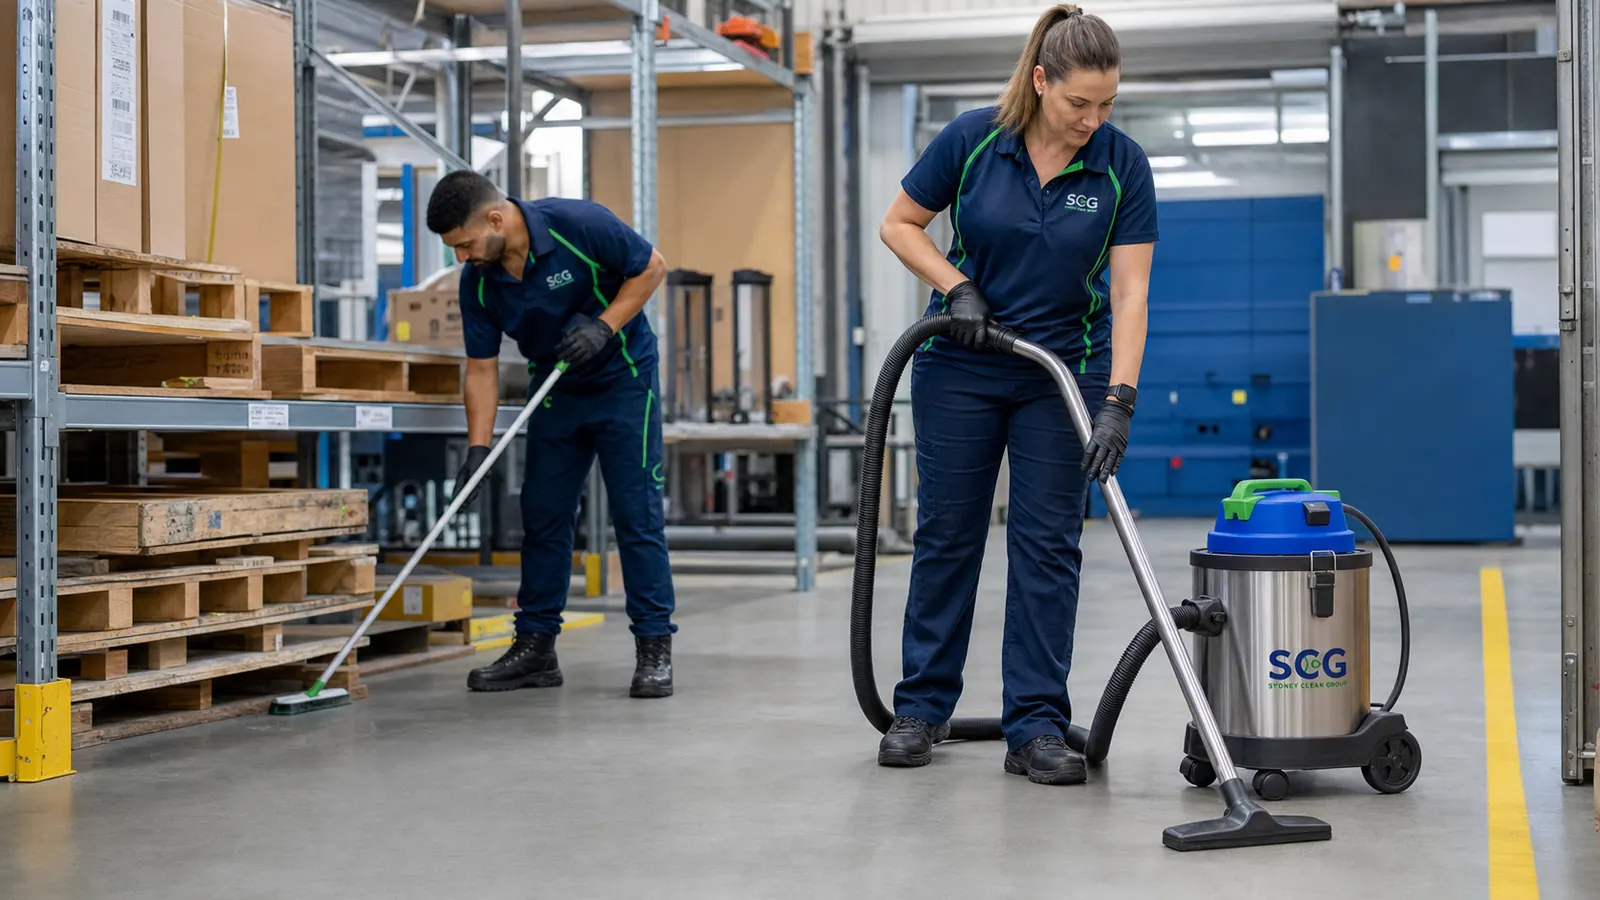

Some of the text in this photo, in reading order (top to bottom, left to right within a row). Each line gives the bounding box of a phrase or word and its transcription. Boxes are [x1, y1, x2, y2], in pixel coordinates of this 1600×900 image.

[1066, 193, 1099, 209] SCG
[546, 269, 573, 288] SCG
[1269, 647, 1347, 680] SCG
